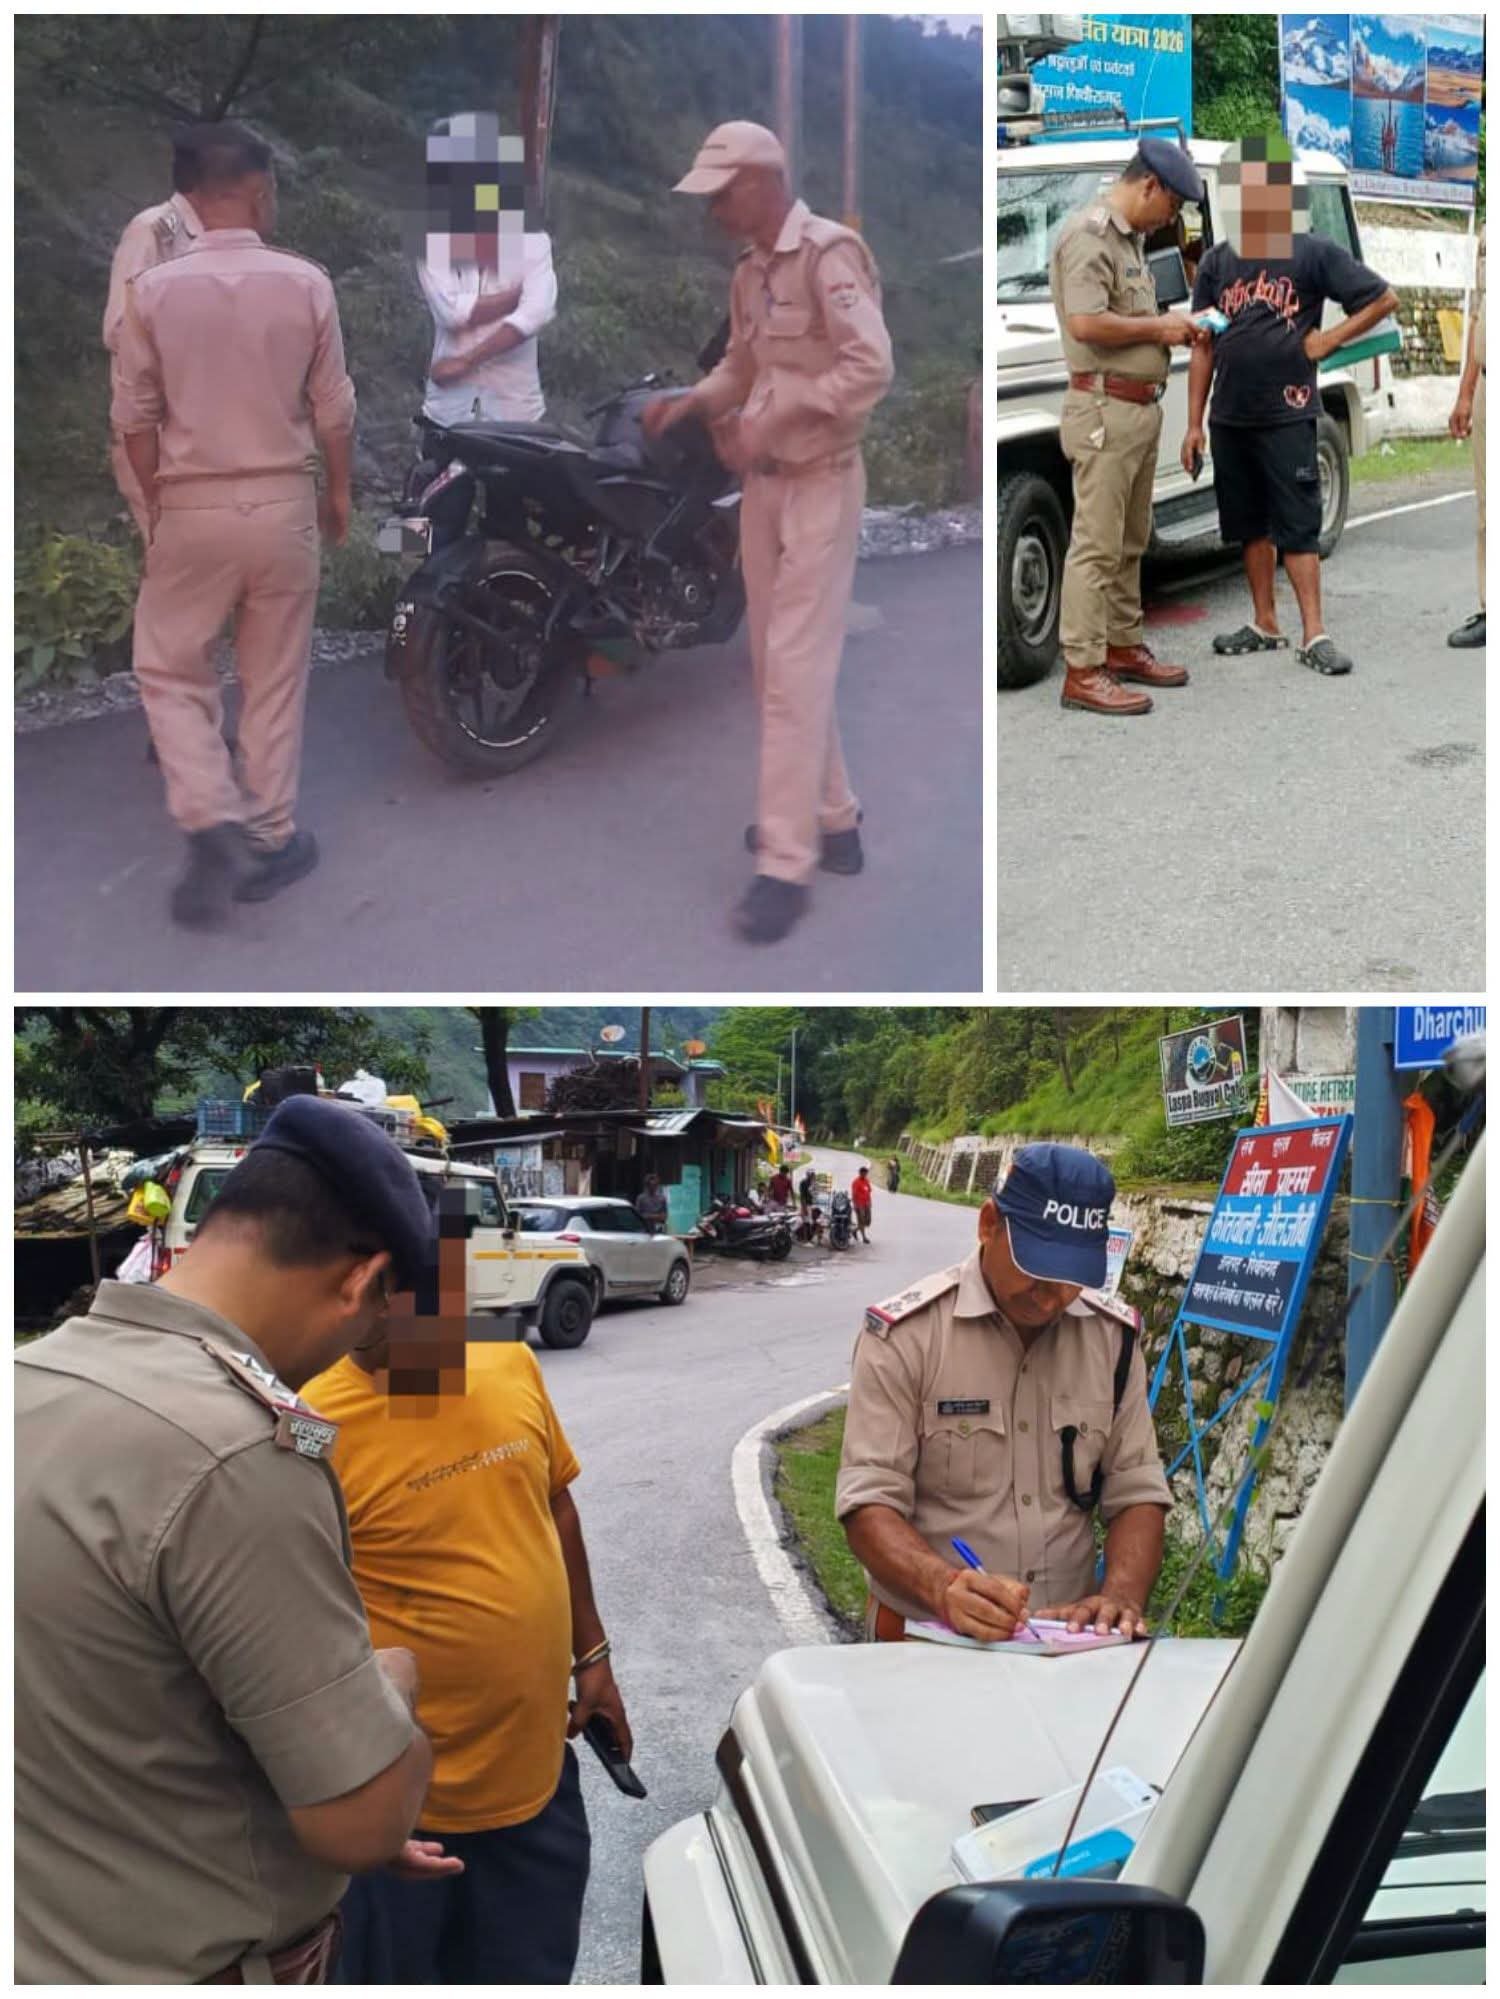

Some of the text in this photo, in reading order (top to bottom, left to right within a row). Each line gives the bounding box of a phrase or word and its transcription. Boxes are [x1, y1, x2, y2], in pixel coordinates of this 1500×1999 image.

[1111, 24, 1150, 49] यात्रा
[1152, 27, 1185, 53] 2026
[1042, 1199, 1105, 1230] POLICE
